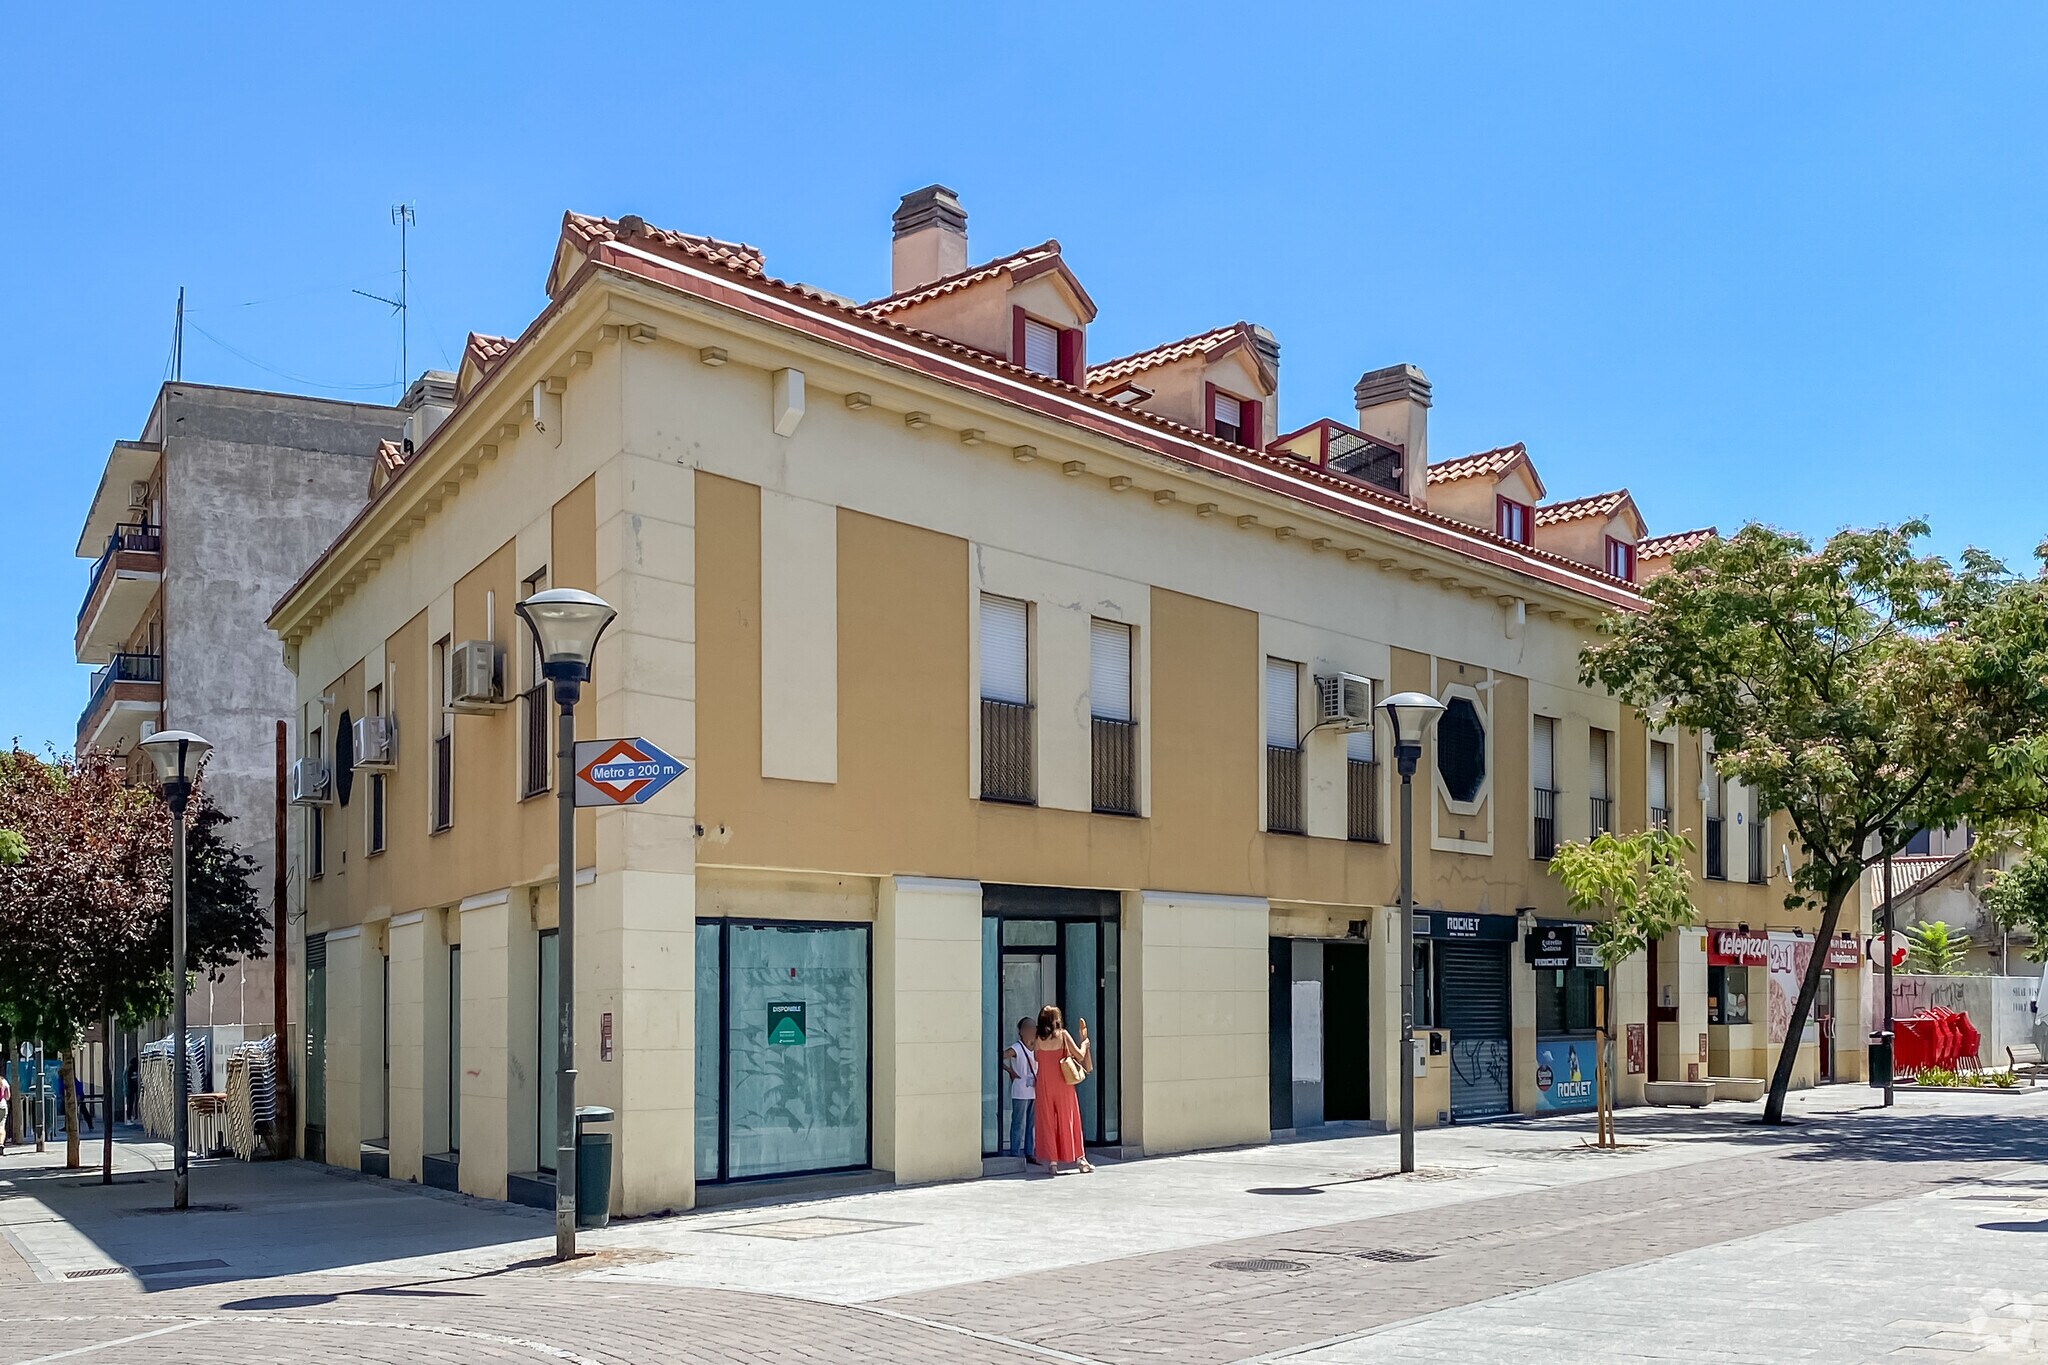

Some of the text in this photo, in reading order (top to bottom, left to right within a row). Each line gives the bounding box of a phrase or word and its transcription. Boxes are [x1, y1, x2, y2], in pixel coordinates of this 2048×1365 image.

[594, 764, 677, 779] Metro a 200 m.
[1447, 917, 1480, 930] ROCKET
[1719, 931, 1767, 964] telepizza
[1535, 957, 1569, 966] ROCKET
[1770, 944, 1794, 973] 2x1
[1557, 1081, 1591, 1097] ROCKET
